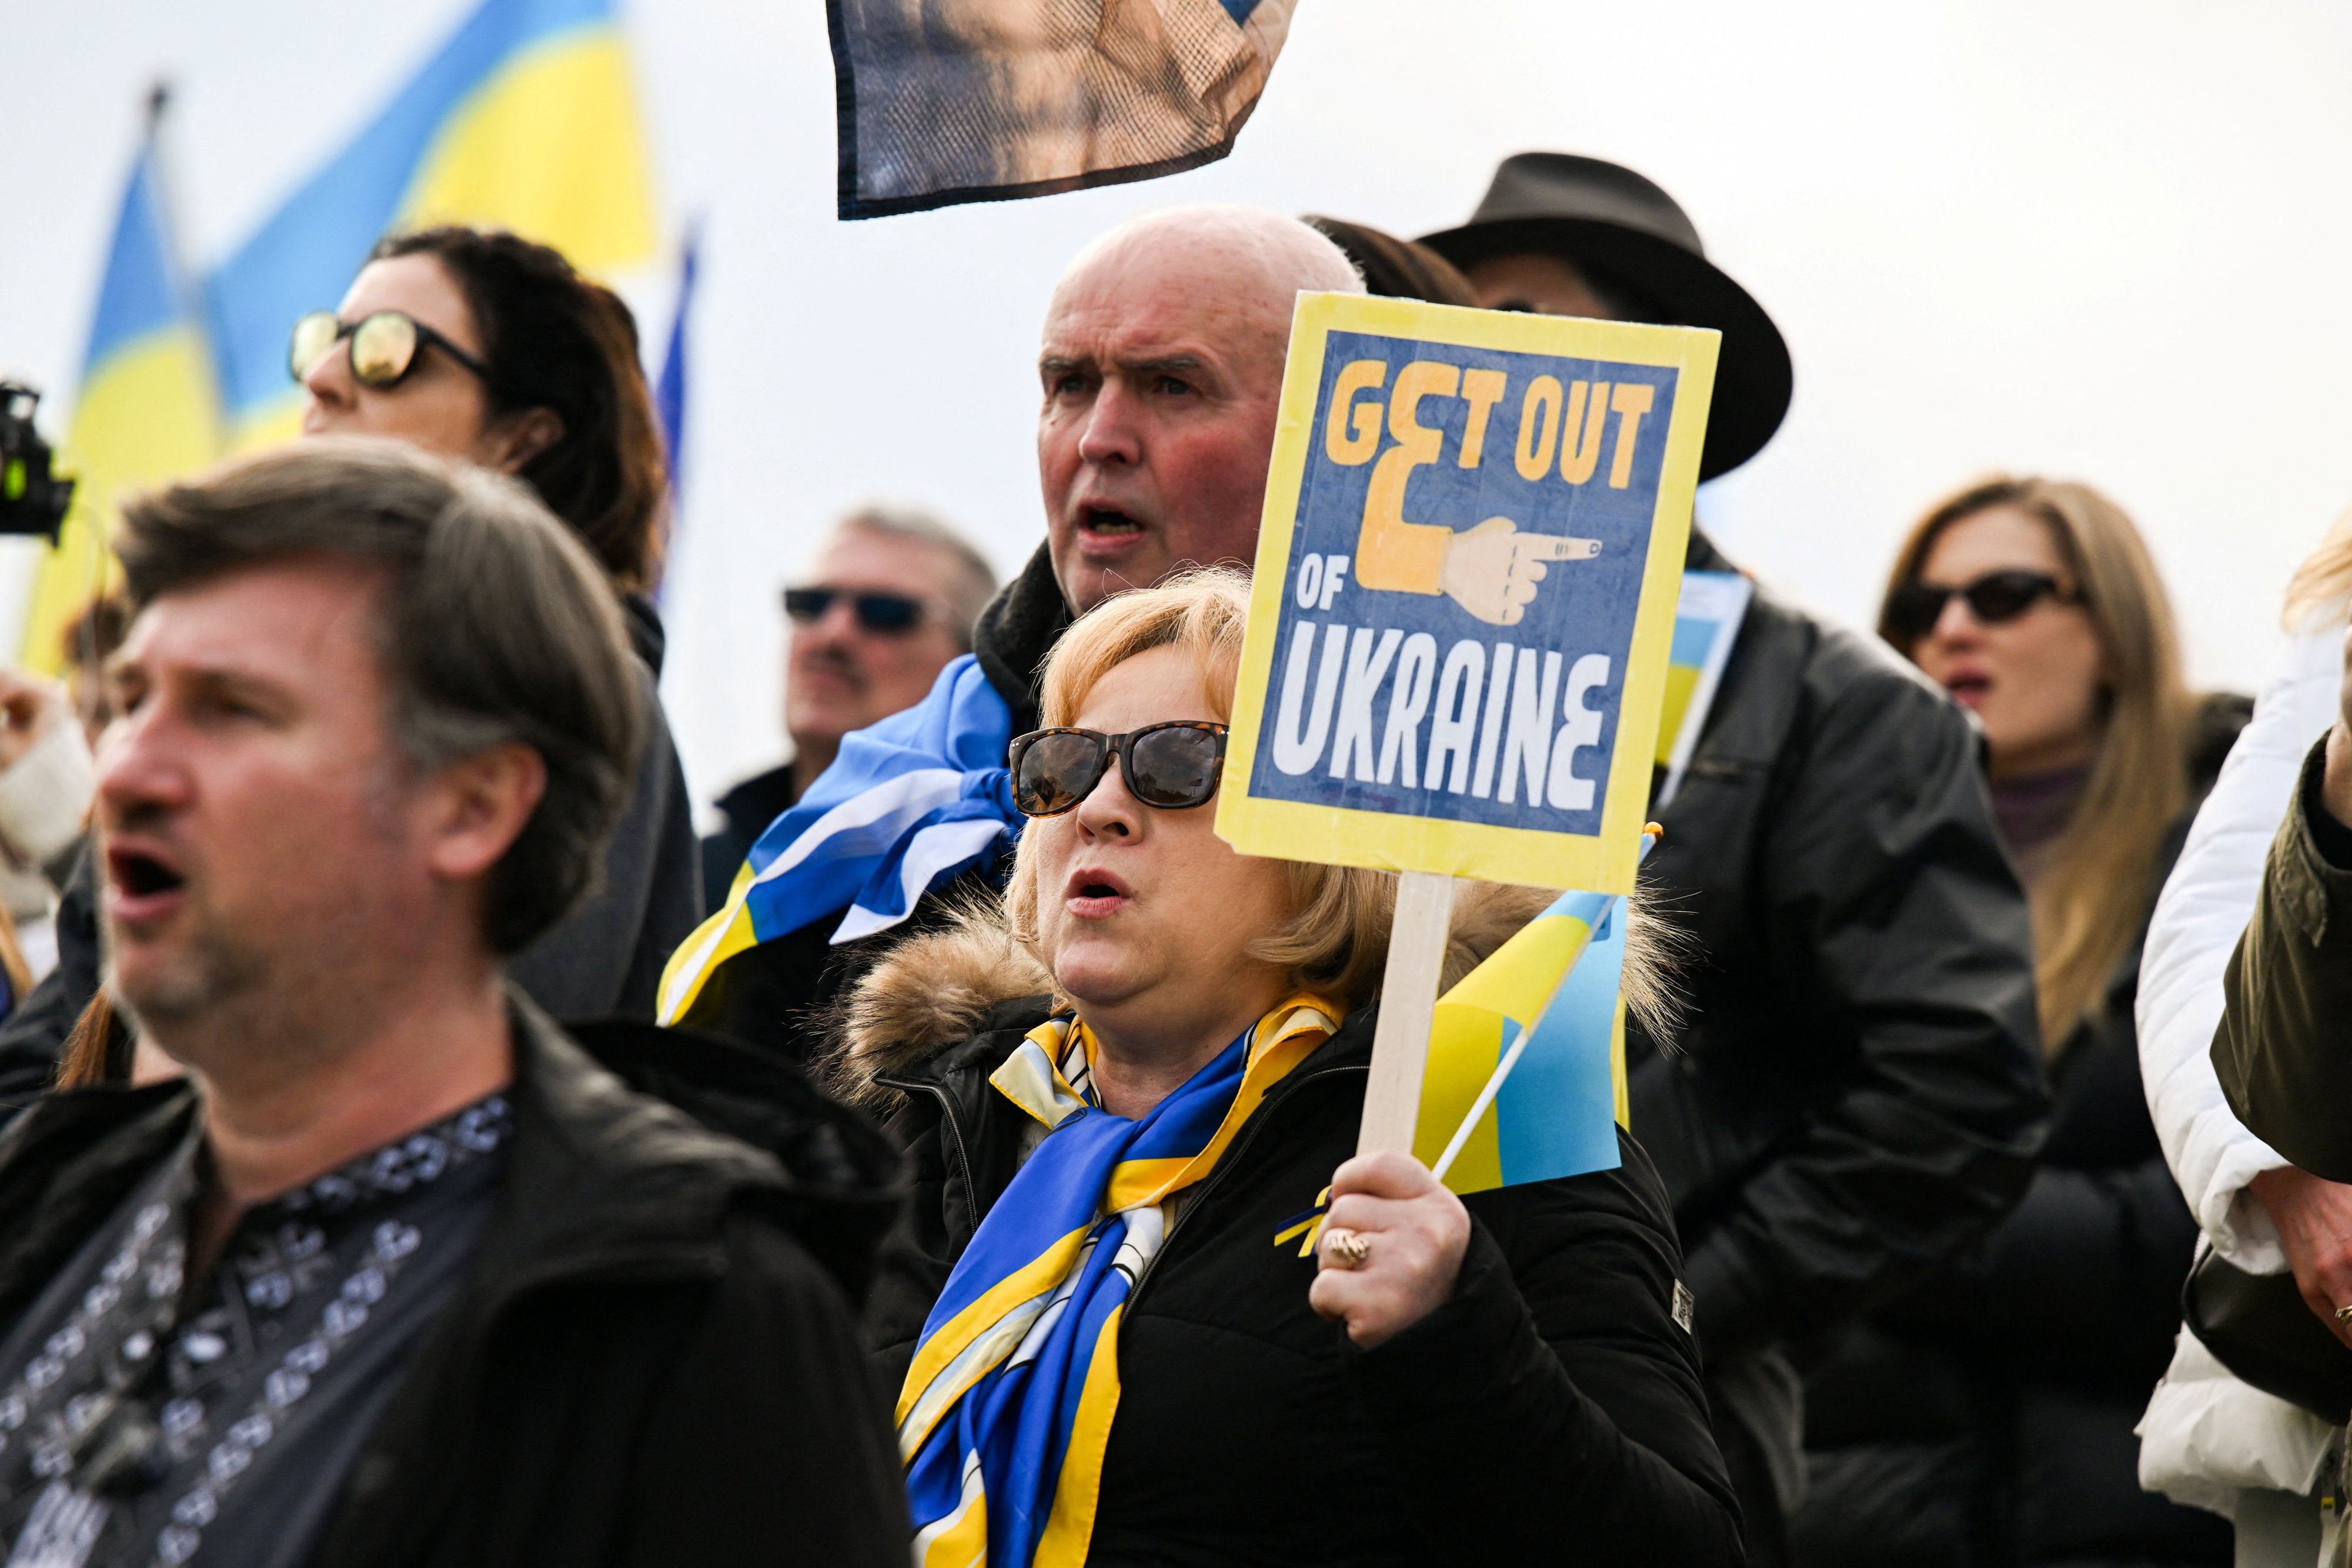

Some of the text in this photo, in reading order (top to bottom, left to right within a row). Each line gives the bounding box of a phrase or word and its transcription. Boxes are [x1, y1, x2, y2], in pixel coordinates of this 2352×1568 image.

[1514, 375, 1655, 489] OUT
[1297, 553, 1349, 610] OF
[1272, 620, 1611, 811] UKRAINE
